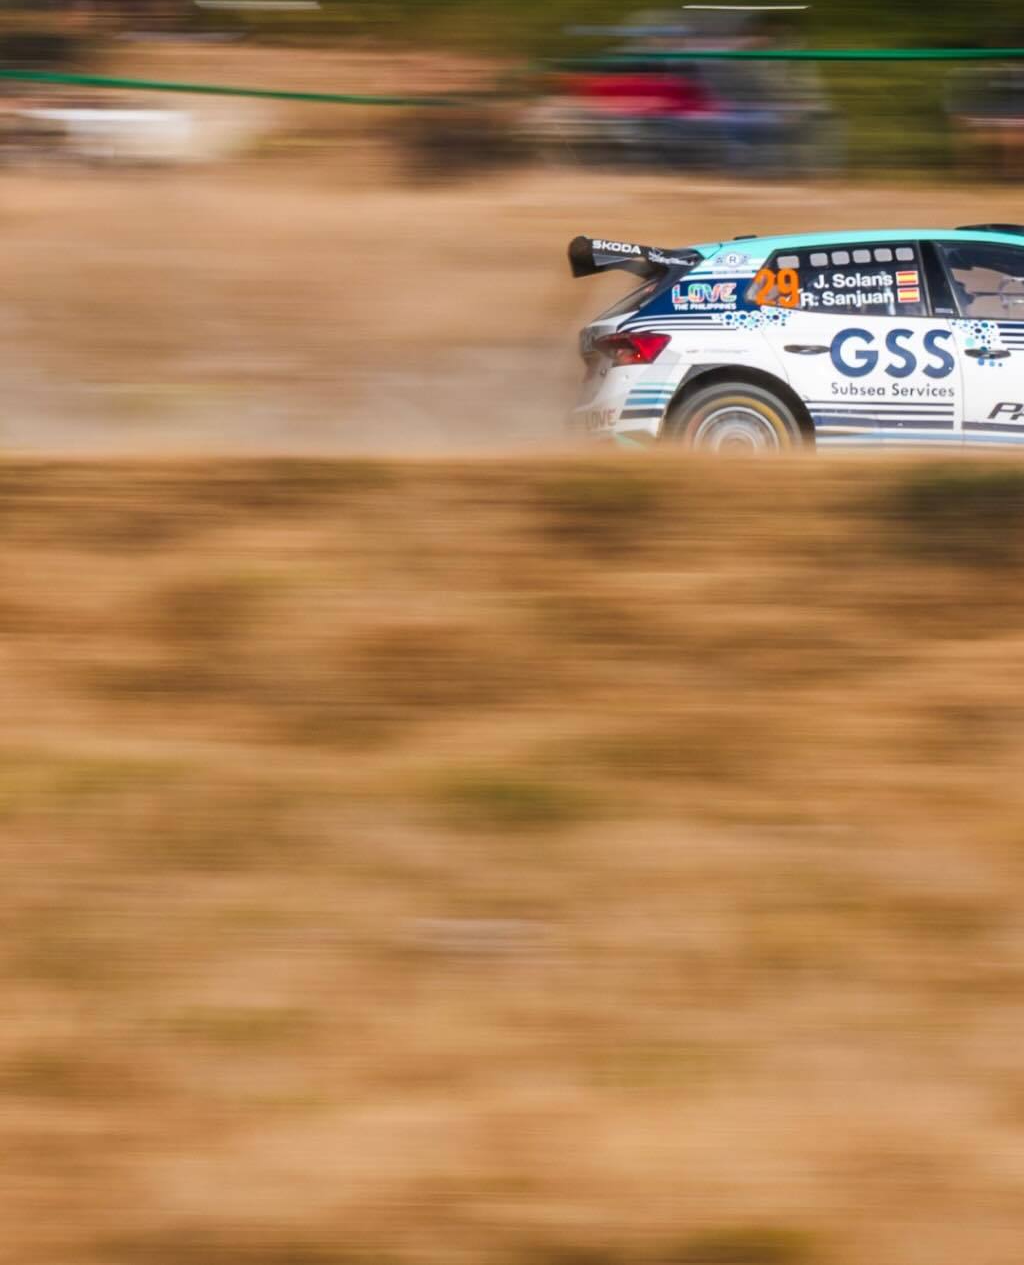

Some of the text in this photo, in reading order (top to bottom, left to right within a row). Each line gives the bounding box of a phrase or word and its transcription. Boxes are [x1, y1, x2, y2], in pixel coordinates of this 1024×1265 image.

[752, 267, 800, 309] 29
[814, 272, 893, 289] J. Solans
[672, 282, 737, 304] LOVE
[801, 290, 895, 307] R. Sanjuan
[830, 327, 955, 379] GSS
[831, 382, 955, 397] Subsea Services
